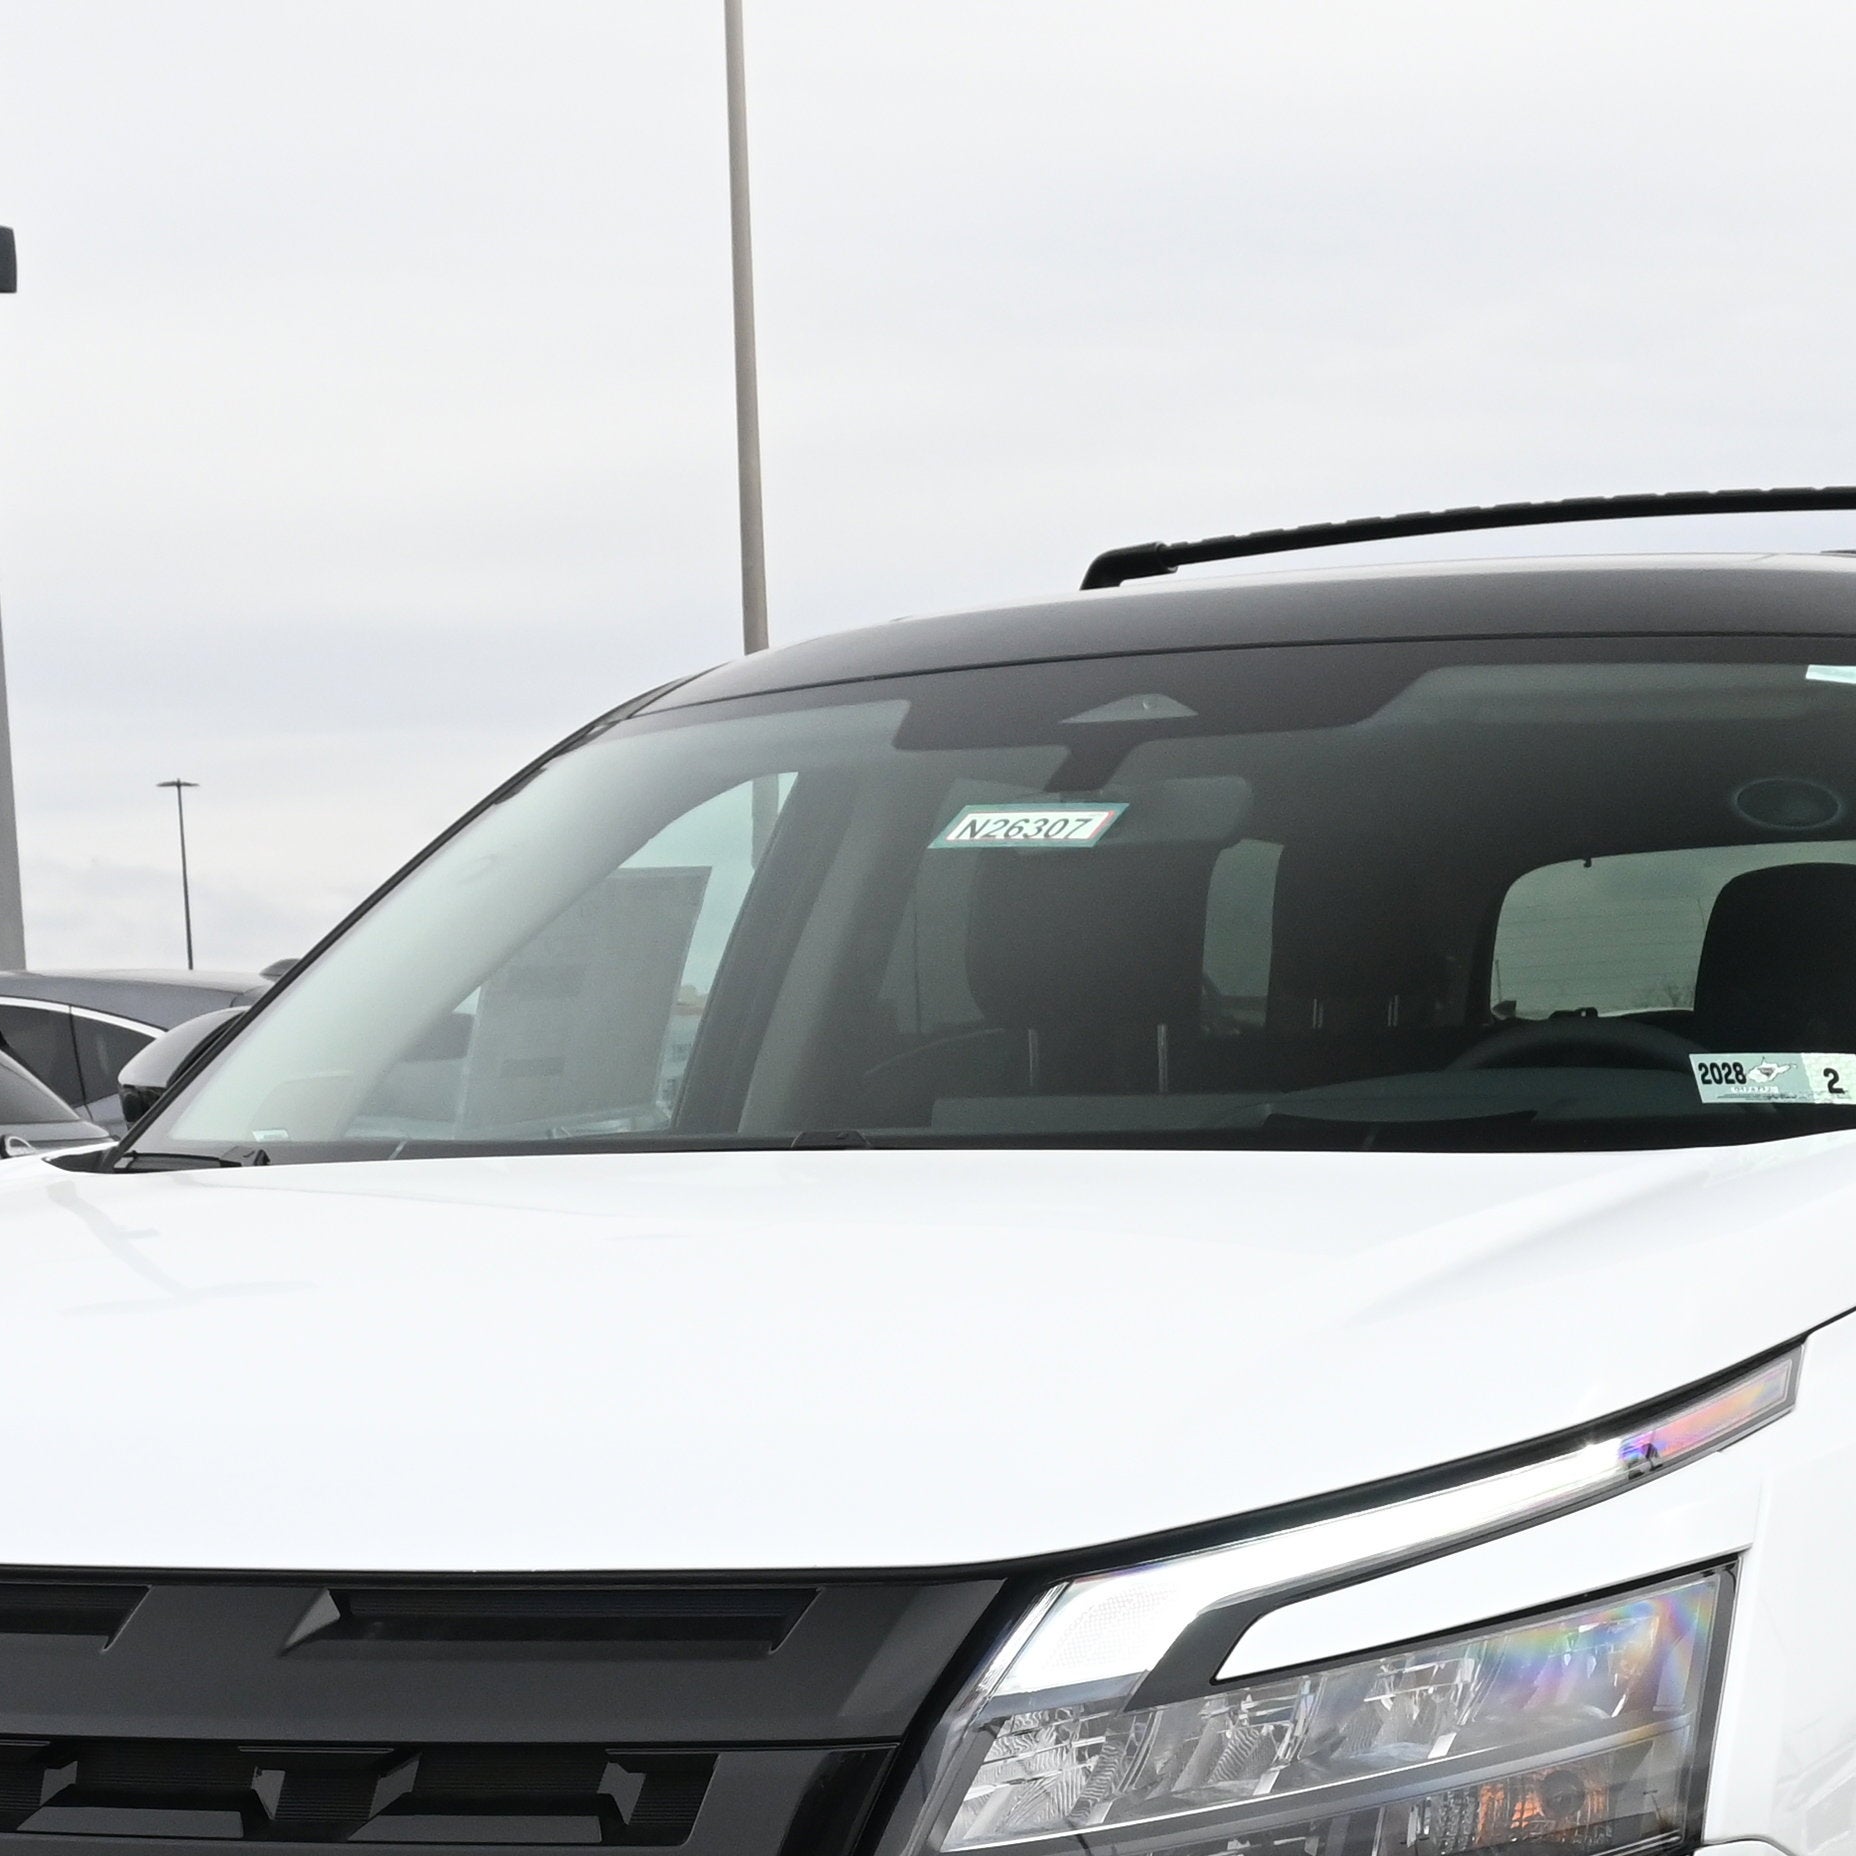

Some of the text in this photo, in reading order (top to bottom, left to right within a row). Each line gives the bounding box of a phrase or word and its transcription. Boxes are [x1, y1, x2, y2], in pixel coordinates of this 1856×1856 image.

[955, 817, 1093, 840] N26307
[1697, 1061, 1747, 1085] 2028
[1822, 1067, 1846, 1095] 2
